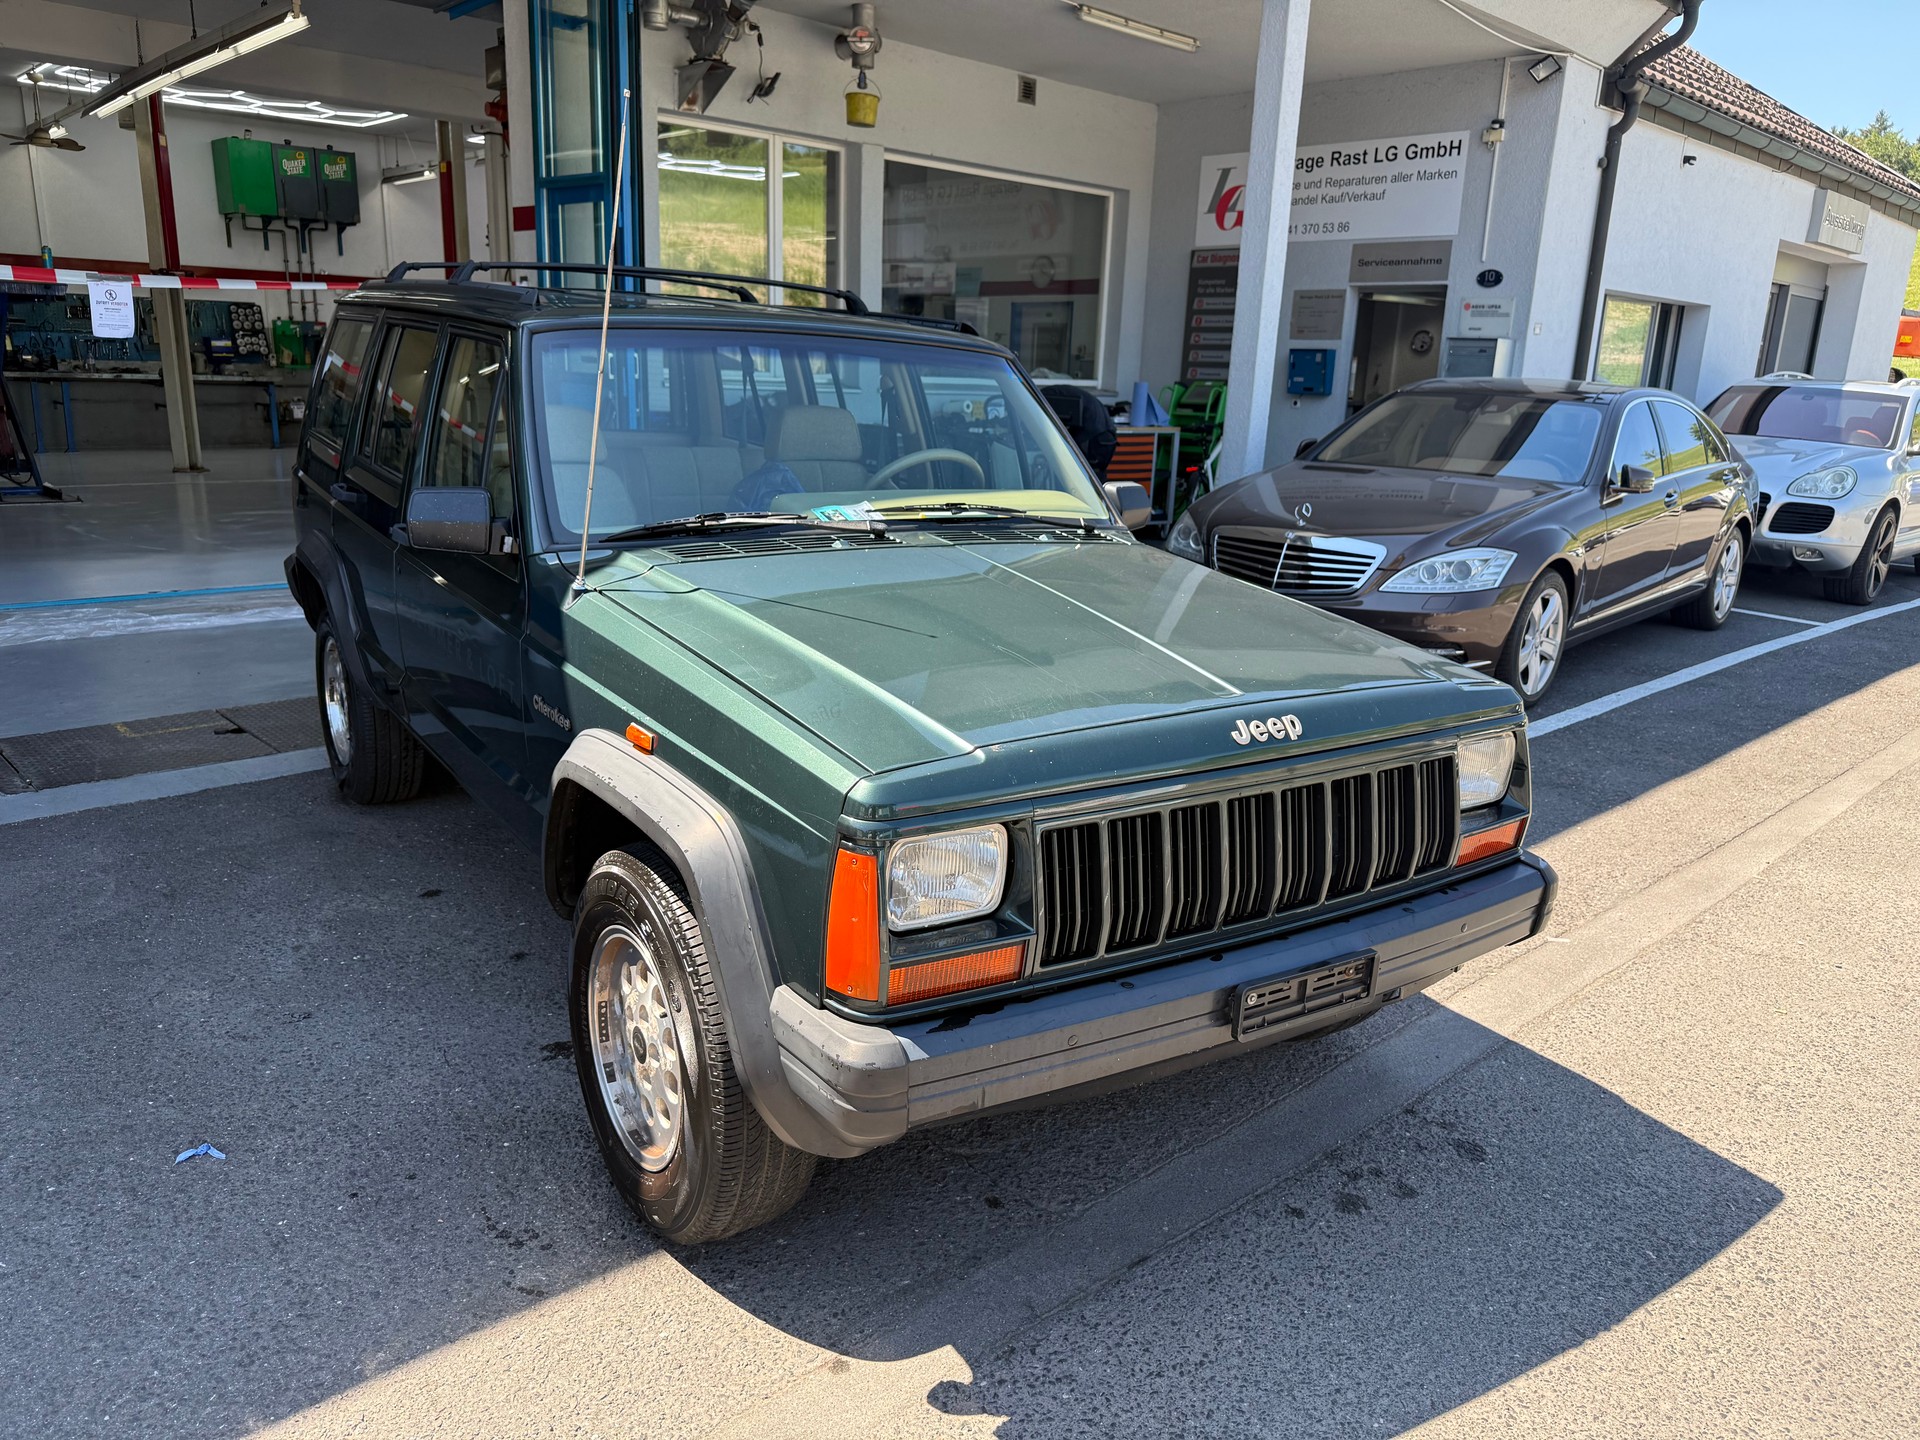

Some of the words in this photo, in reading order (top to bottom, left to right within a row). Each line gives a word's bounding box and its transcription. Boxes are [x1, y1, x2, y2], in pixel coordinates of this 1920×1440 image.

[1294, 156, 1325, 173] age
[1330, 148, 1368, 167] Rast
[1373, 145, 1398, 164] LG
[1405, 139, 1462, 161] GmbH
[282, 158, 306, 171] QUAKER
[287, 166, 304, 176] STATE
[324, 163, 347, 175] QUAKER
[328, 171, 345, 180] STATE
[1304, 178, 1322, 190] und
[1324, 174, 1388, 190] Reparaturen
[1390, 171, 1414, 184] aller
[1416, 168, 1458, 182] Marken
[1291, 194, 1318, 207] andel
[1321, 189, 1386, 205] Kauf/Verkauf
[1301, 223, 1319, 235] 370
[1322, 222, 1335, 233] 53
[1337, 221, 1350, 233] 86
[1822, 204, 1866, 242] Ausstellung
[1196, 254, 1209, 264] Car
[1358, 257, 1443, 268] Serviceannahme
[1485, 271, 1496, 281] 10
[532, 693, 571, 732] Cherokee
[1231, 714, 1303, 745] Jeep
